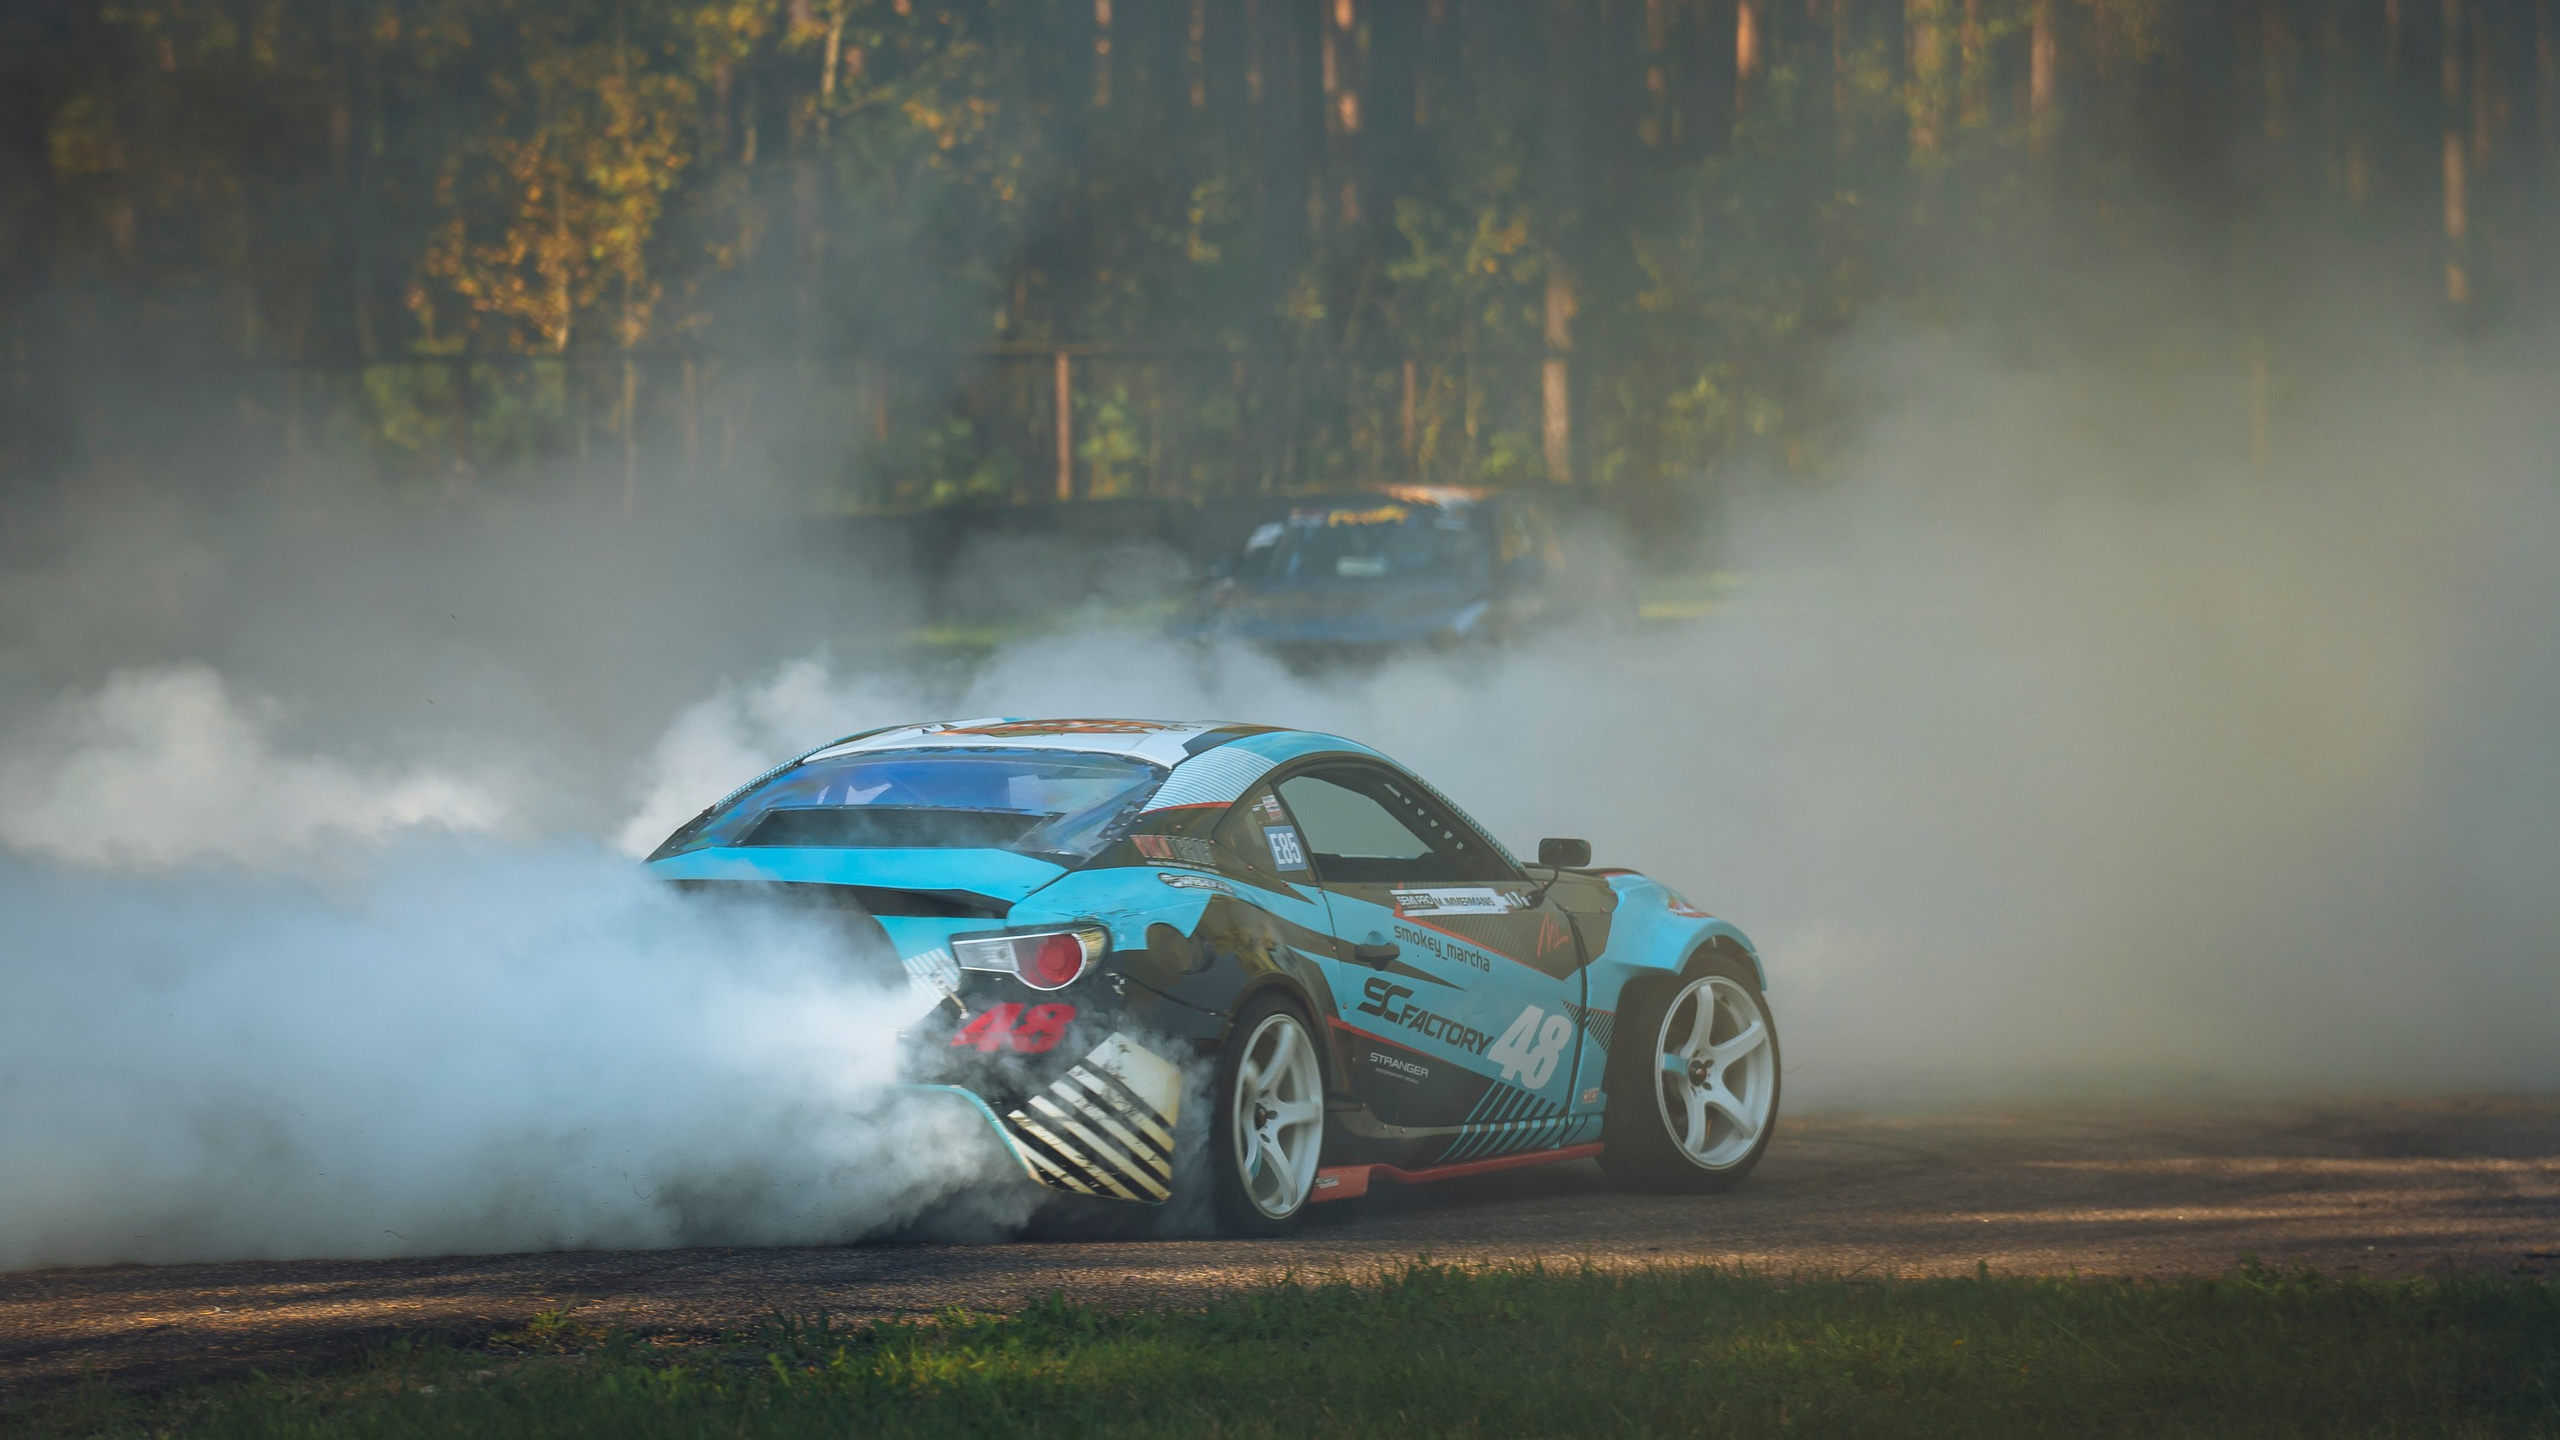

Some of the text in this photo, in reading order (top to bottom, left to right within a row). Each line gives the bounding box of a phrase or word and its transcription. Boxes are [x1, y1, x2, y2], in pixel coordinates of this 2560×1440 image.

[1268, 832, 1303, 865] E85
[1393, 924, 1491, 973] smokey_marcha
[950, 1002, 1077, 1054] 48
[1396, 1003, 1495, 1056] FACTORY
[1486, 1004, 1572, 1090] 48
[1369, 1052, 1430, 1078] STRANGER
